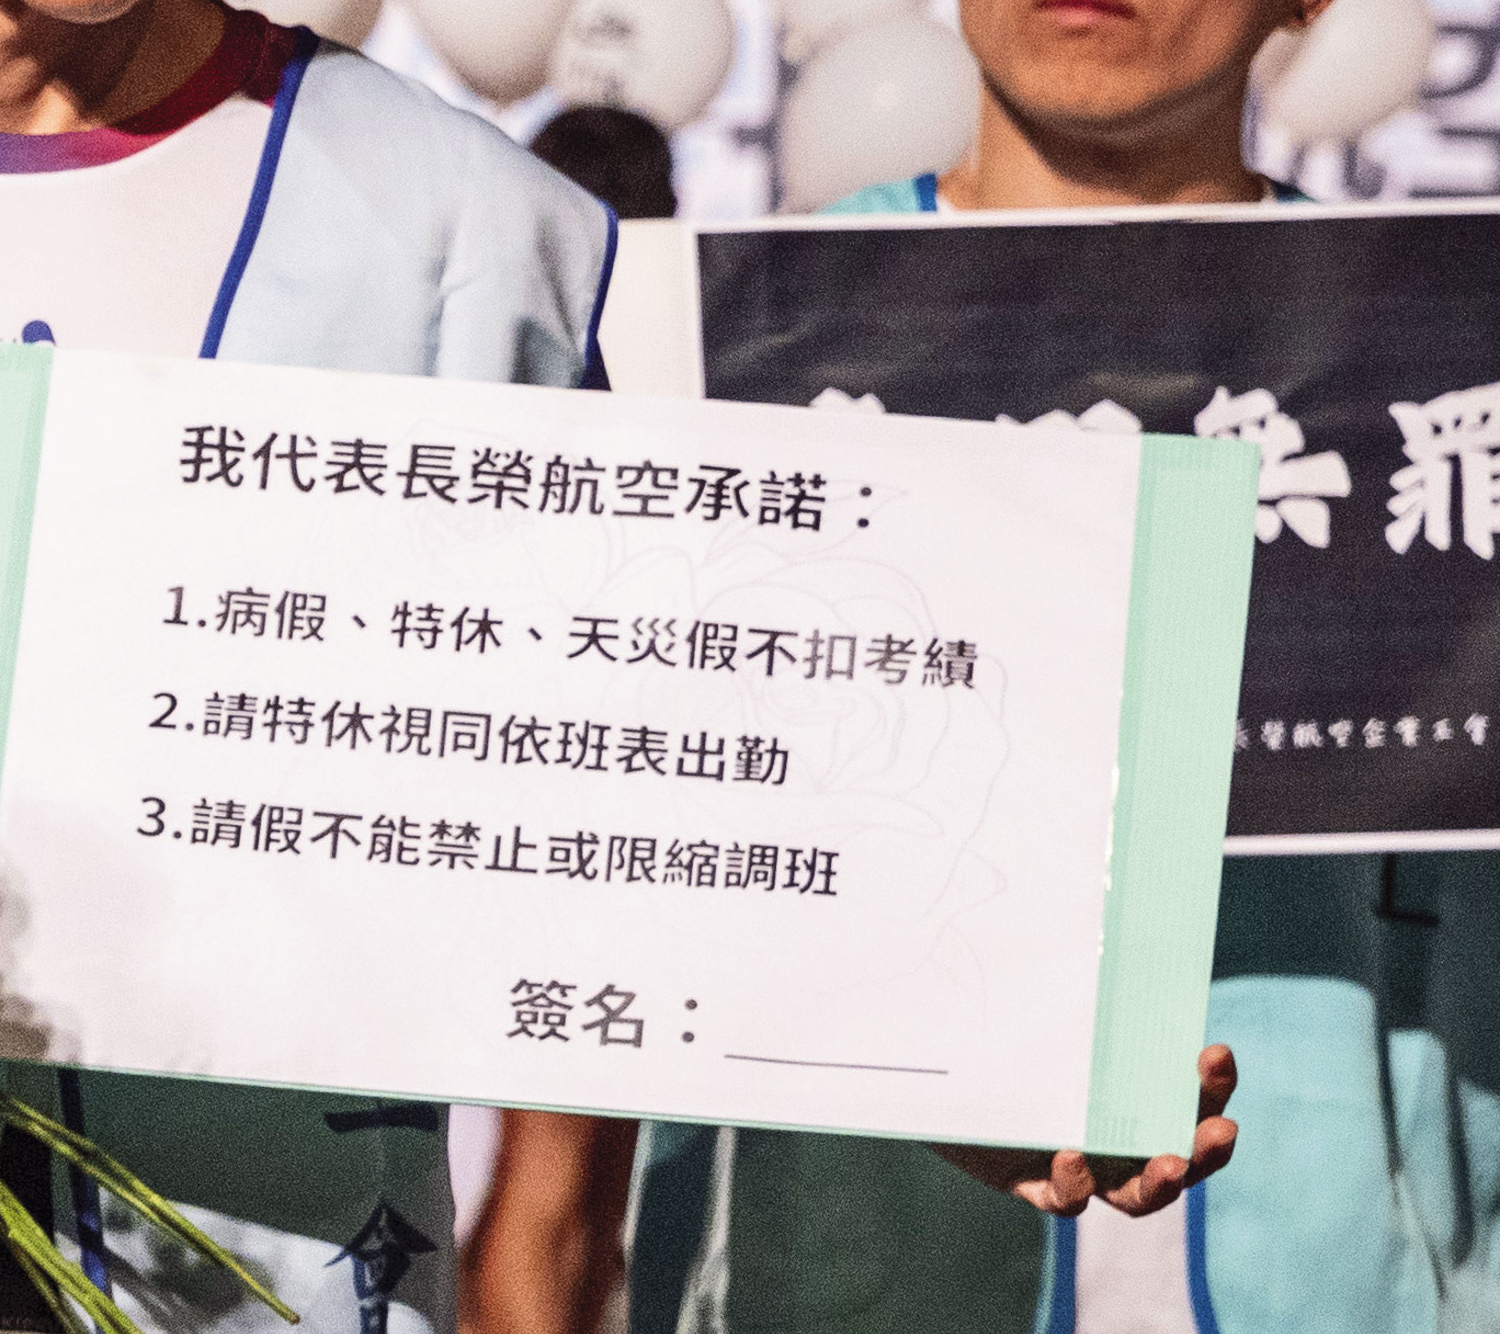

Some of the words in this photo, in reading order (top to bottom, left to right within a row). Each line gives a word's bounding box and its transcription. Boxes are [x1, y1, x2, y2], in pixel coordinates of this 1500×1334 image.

[180, 422, 875, 533] 我代表長榮航空承諾：
[808, 384, 1500, 560] 無罪
[161, 583, 980, 691] 1.病假、特休、天災假不扣考績
[147, 689, 792, 786] 2.請特休視同依班表出勤
[135, 794, 842, 899] 3.請假不能禁止或限縮調班
